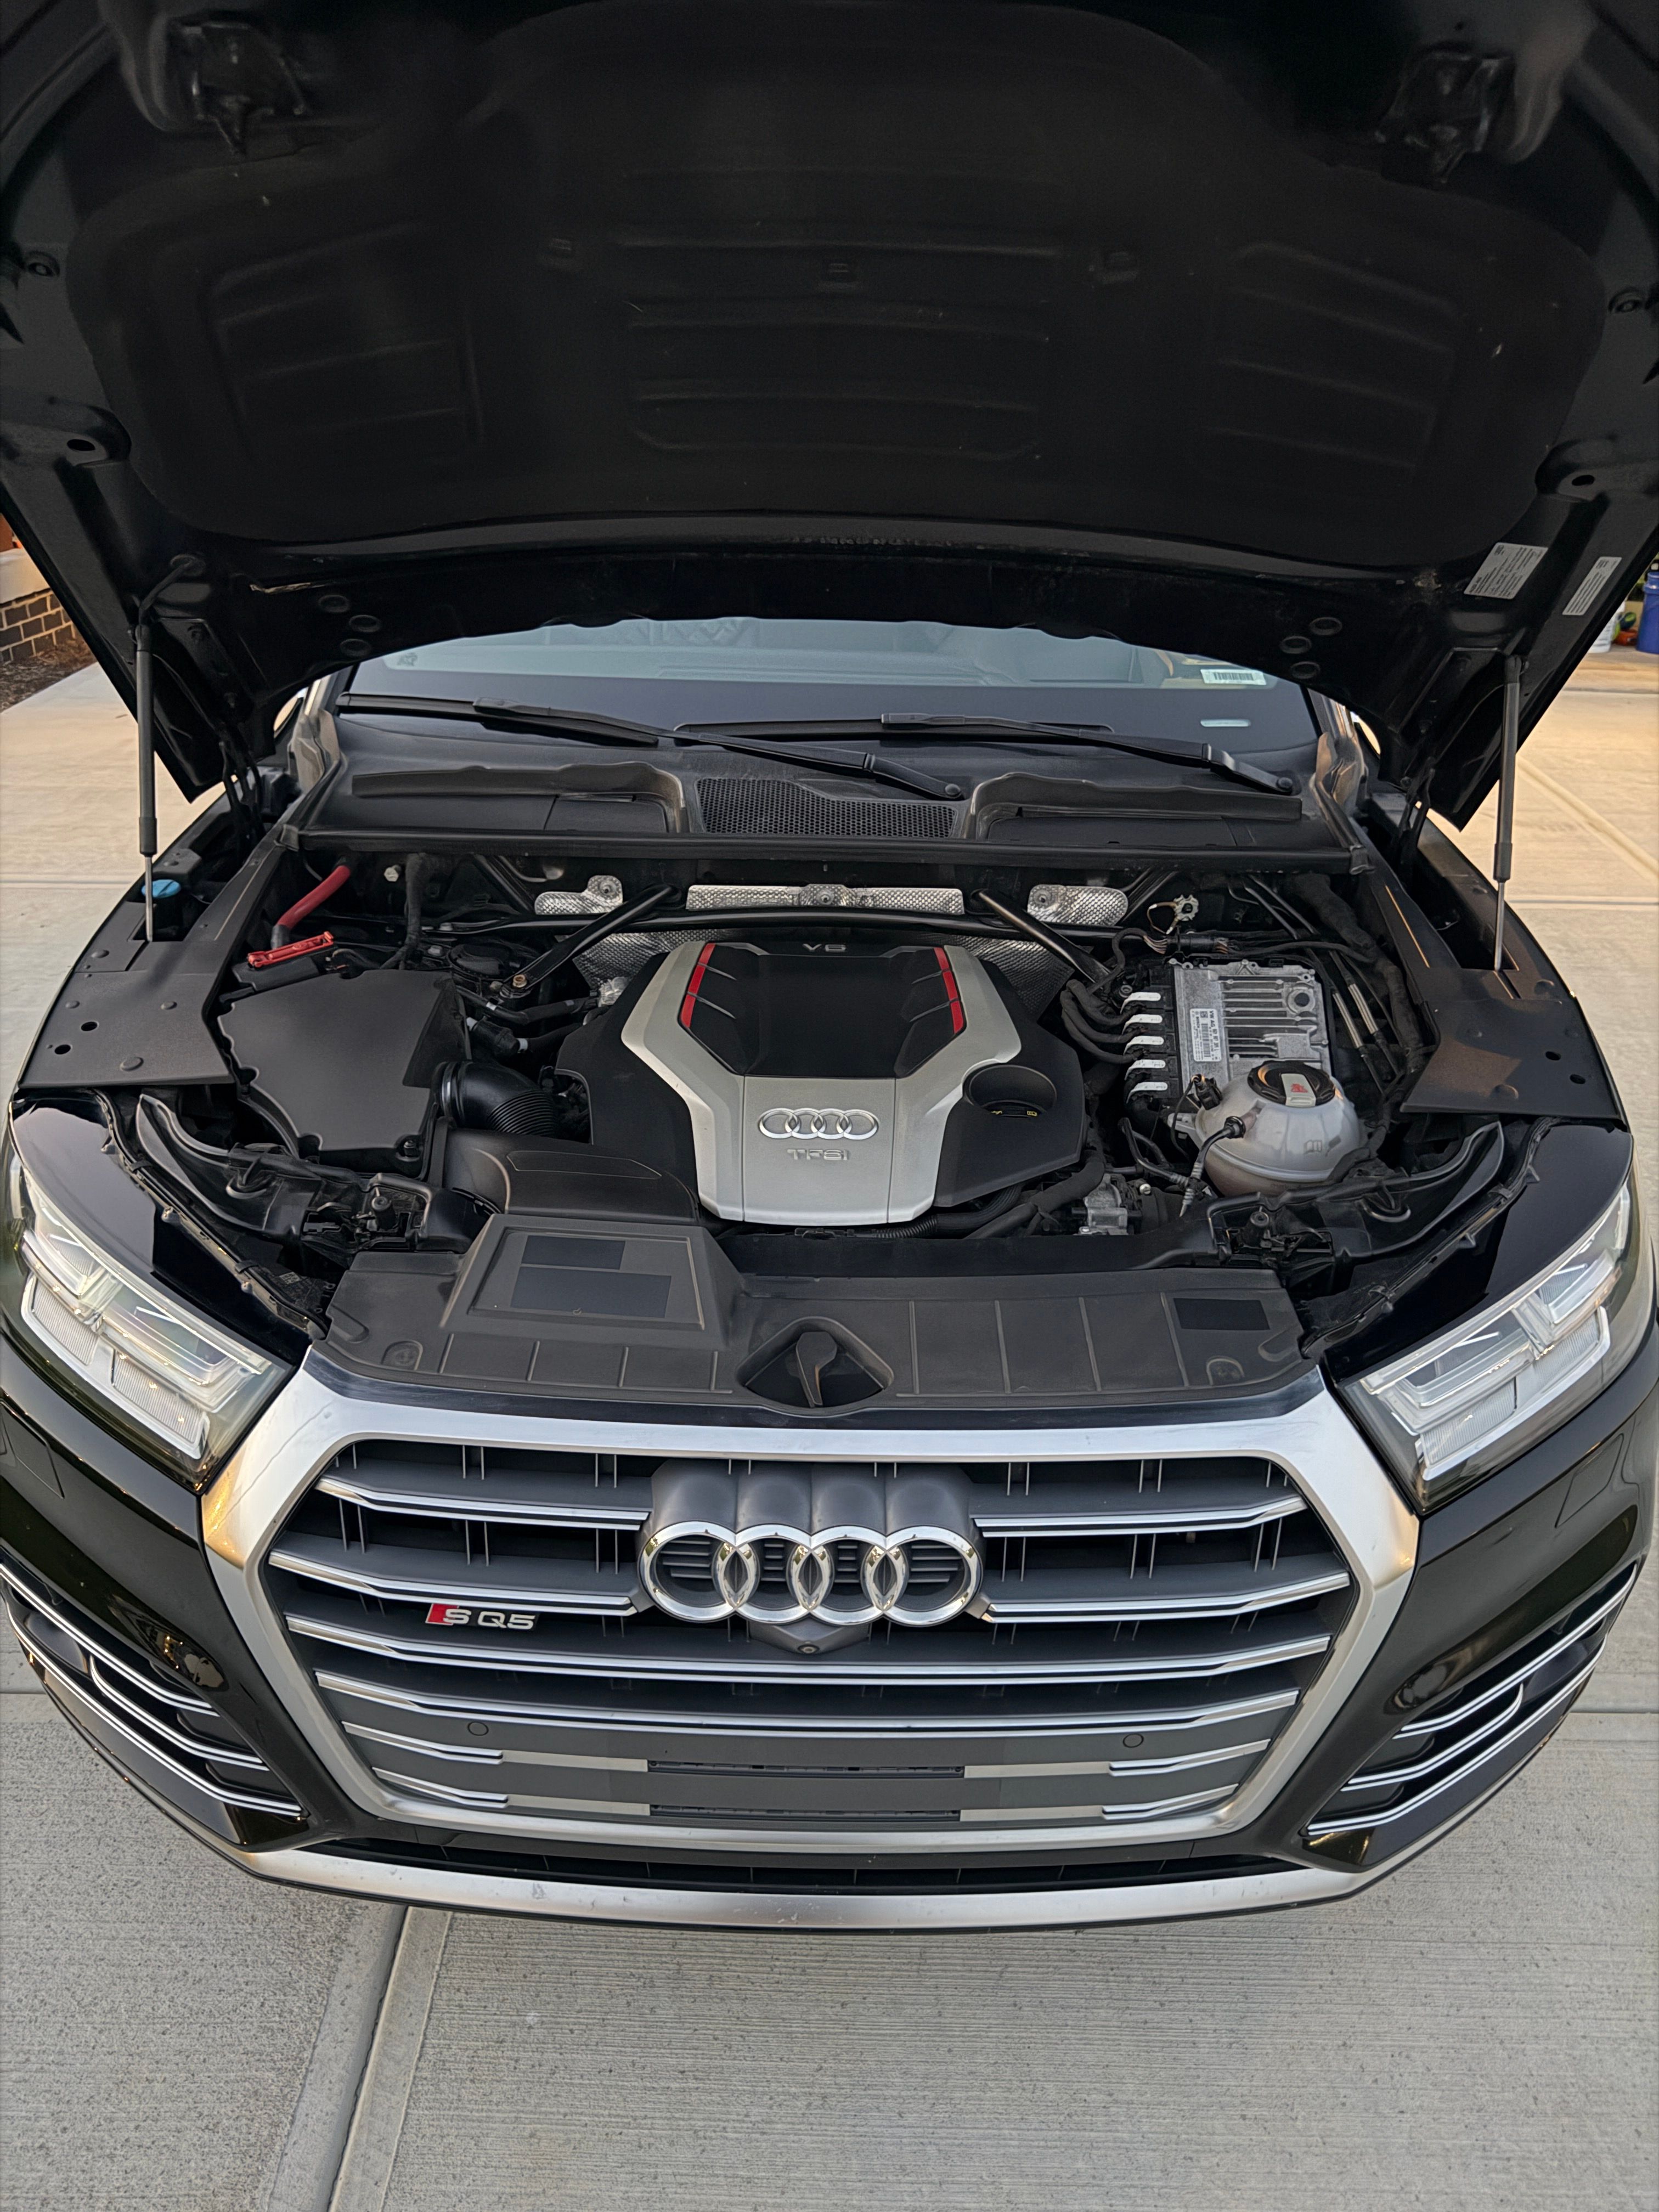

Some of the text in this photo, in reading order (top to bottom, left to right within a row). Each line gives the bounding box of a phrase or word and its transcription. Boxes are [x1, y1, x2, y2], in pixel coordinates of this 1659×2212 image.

[803, 943, 847, 953] V6
[1209, 1010, 1214, 1019] VW
[787, 1149, 849, 1160] TFSI
